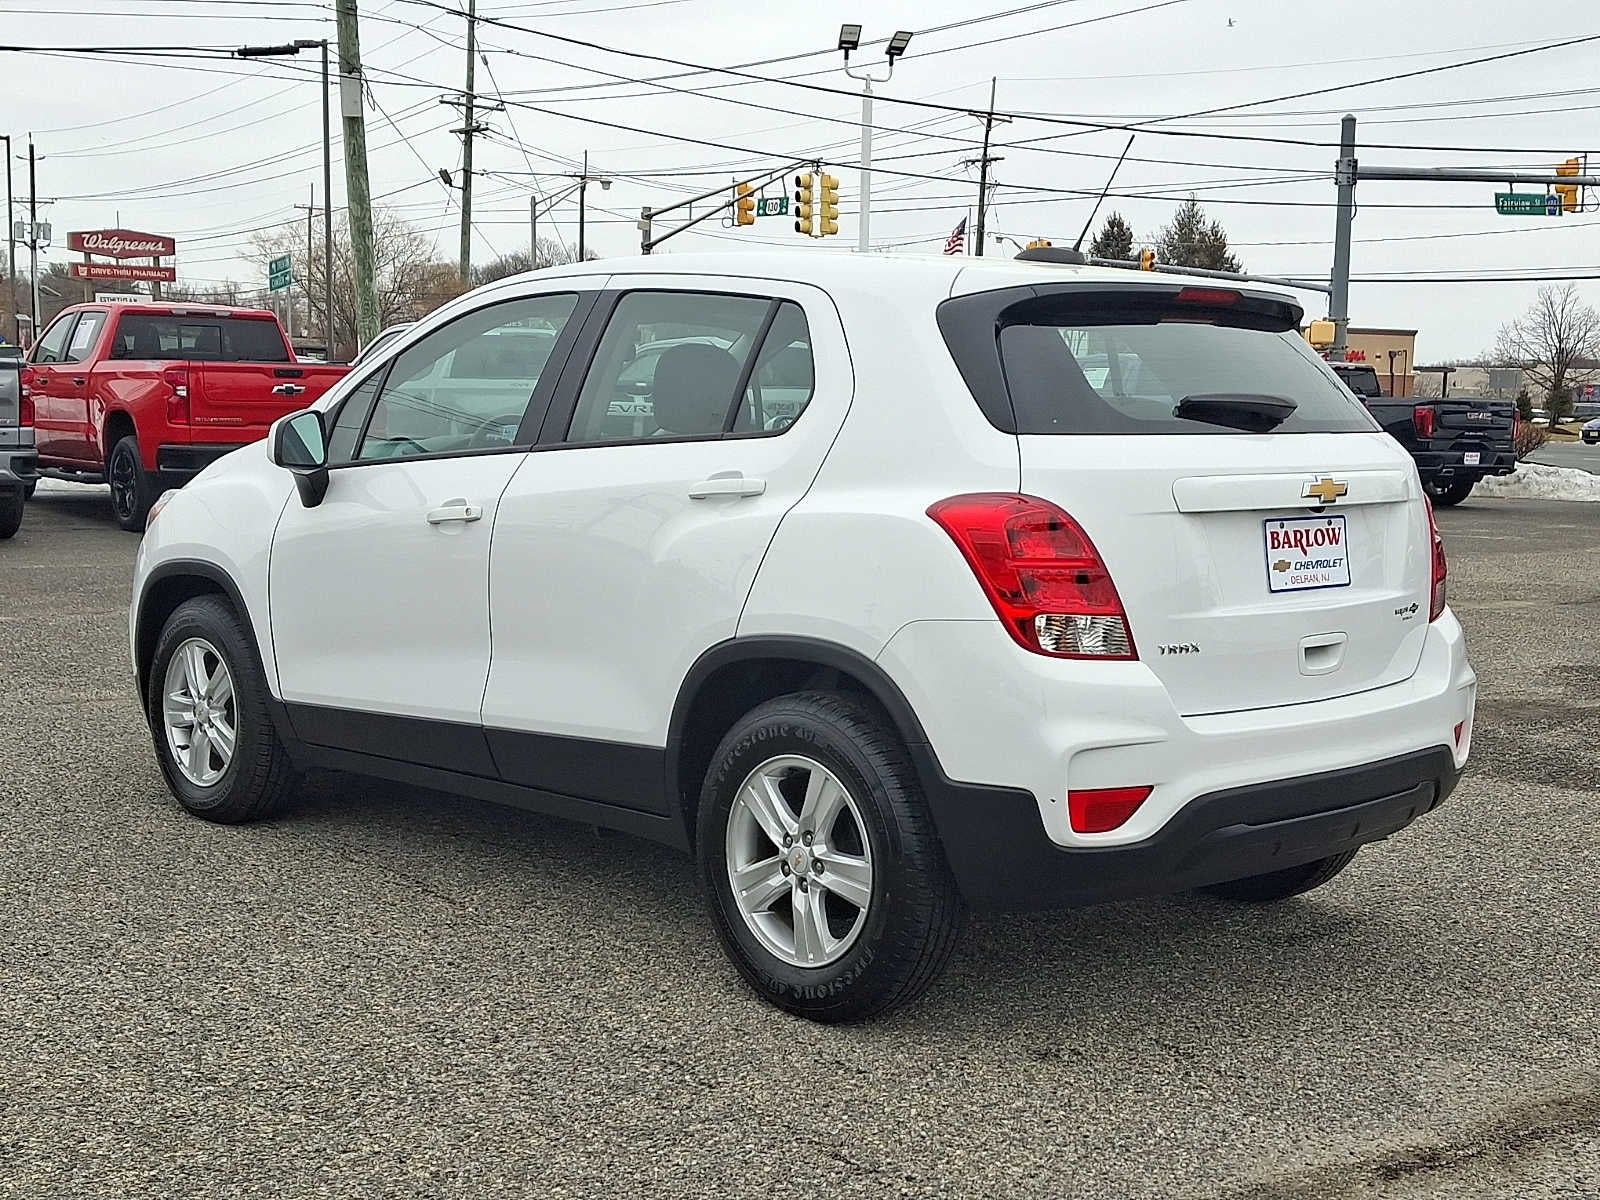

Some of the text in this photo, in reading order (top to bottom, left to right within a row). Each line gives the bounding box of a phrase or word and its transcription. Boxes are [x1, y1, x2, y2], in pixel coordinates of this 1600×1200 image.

[767, 201, 778, 212] 130
[1499, 197, 1530, 211] Fairview
[81, 233, 165, 253] Walgreens
[90, 267, 170, 278] DRIVE-THRU PHARMACY
[1270, 527, 1341, 557] BARLOW
[1294, 558, 1344, 571] CHEVROLET
[1321, 573, 1330, 582] NJ
[1157, 643, 1200, 655] TRAX
